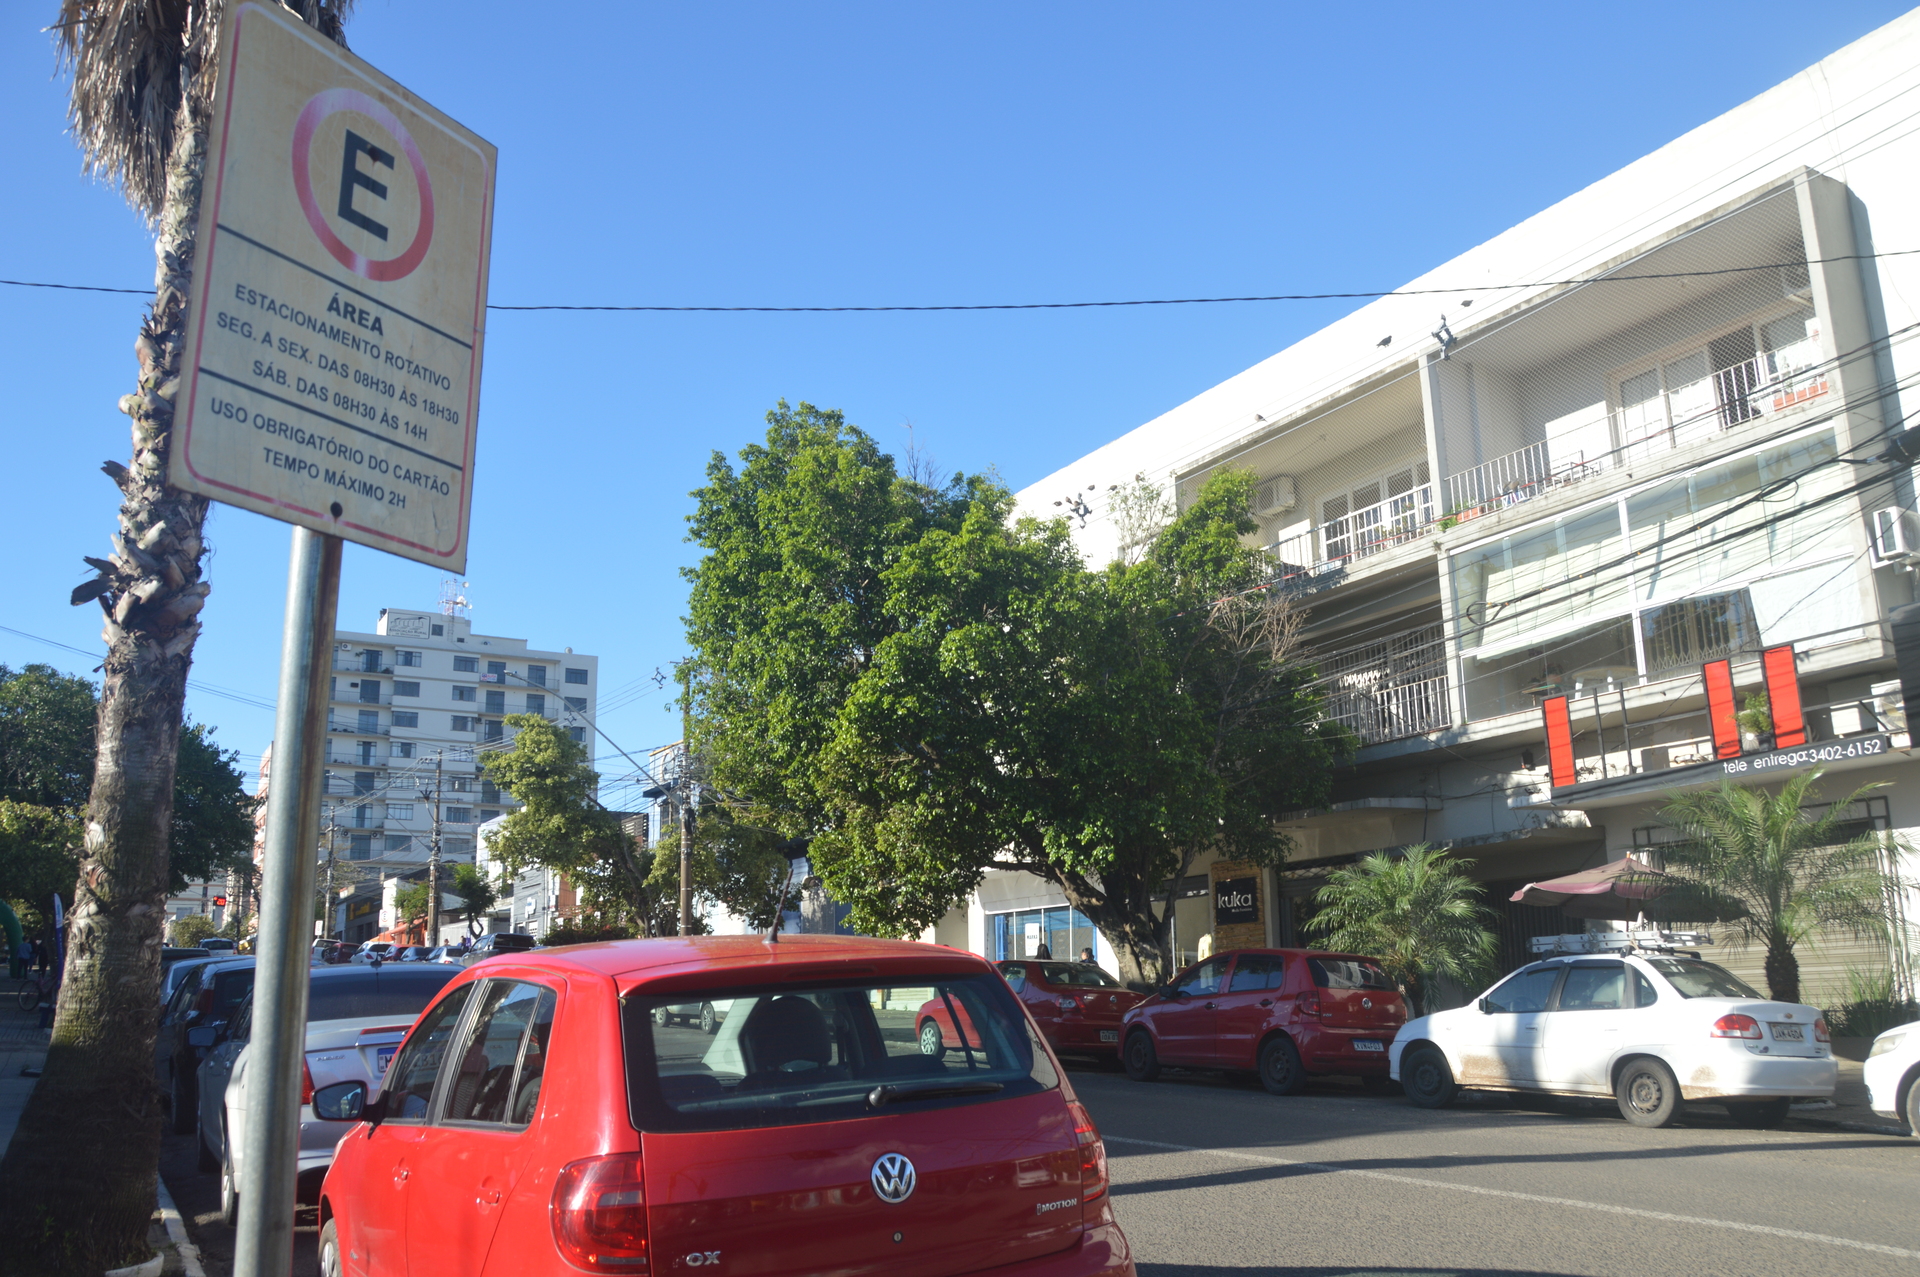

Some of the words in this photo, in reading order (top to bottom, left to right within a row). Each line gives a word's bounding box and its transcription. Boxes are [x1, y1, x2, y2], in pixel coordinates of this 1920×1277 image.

[337, 128, 395, 243] E
[235, 283, 381, 360] ESTACIONAMENTO
[384, 350, 451, 391] ROTATIVO
[326, 292, 384, 337] ÁREA
[216, 312, 257, 341] SEG.
[261, 331, 273, 348] A
[277, 337, 313, 365] SEX.
[318, 353, 349, 379] DAS
[353, 369, 396, 399] 08H30
[399, 386, 418, 408] ÀS
[422, 398, 460, 426] 18H30
[252, 359, 291, 388] SÁB.
[296, 376, 329, 402] DAS
[333, 392, 376, 422] 08H30
[379, 408, 400, 431] ÀS
[403, 421, 428, 442] 14H
[211, 397, 248, 424] USO
[253, 413, 364, 465] OBRIGATÓRIO
[368, 455, 389, 475] DO
[393, 465, 451, 497] CARTÃO
[263, 447, 320, 479] TEMPO
[324, 468, 385, 502] MÁXIMO
[388, 490, 407, 510] 2H
[1723, 760, 1748, 774] tele
[1217, 890, 1252, 909] kuka
